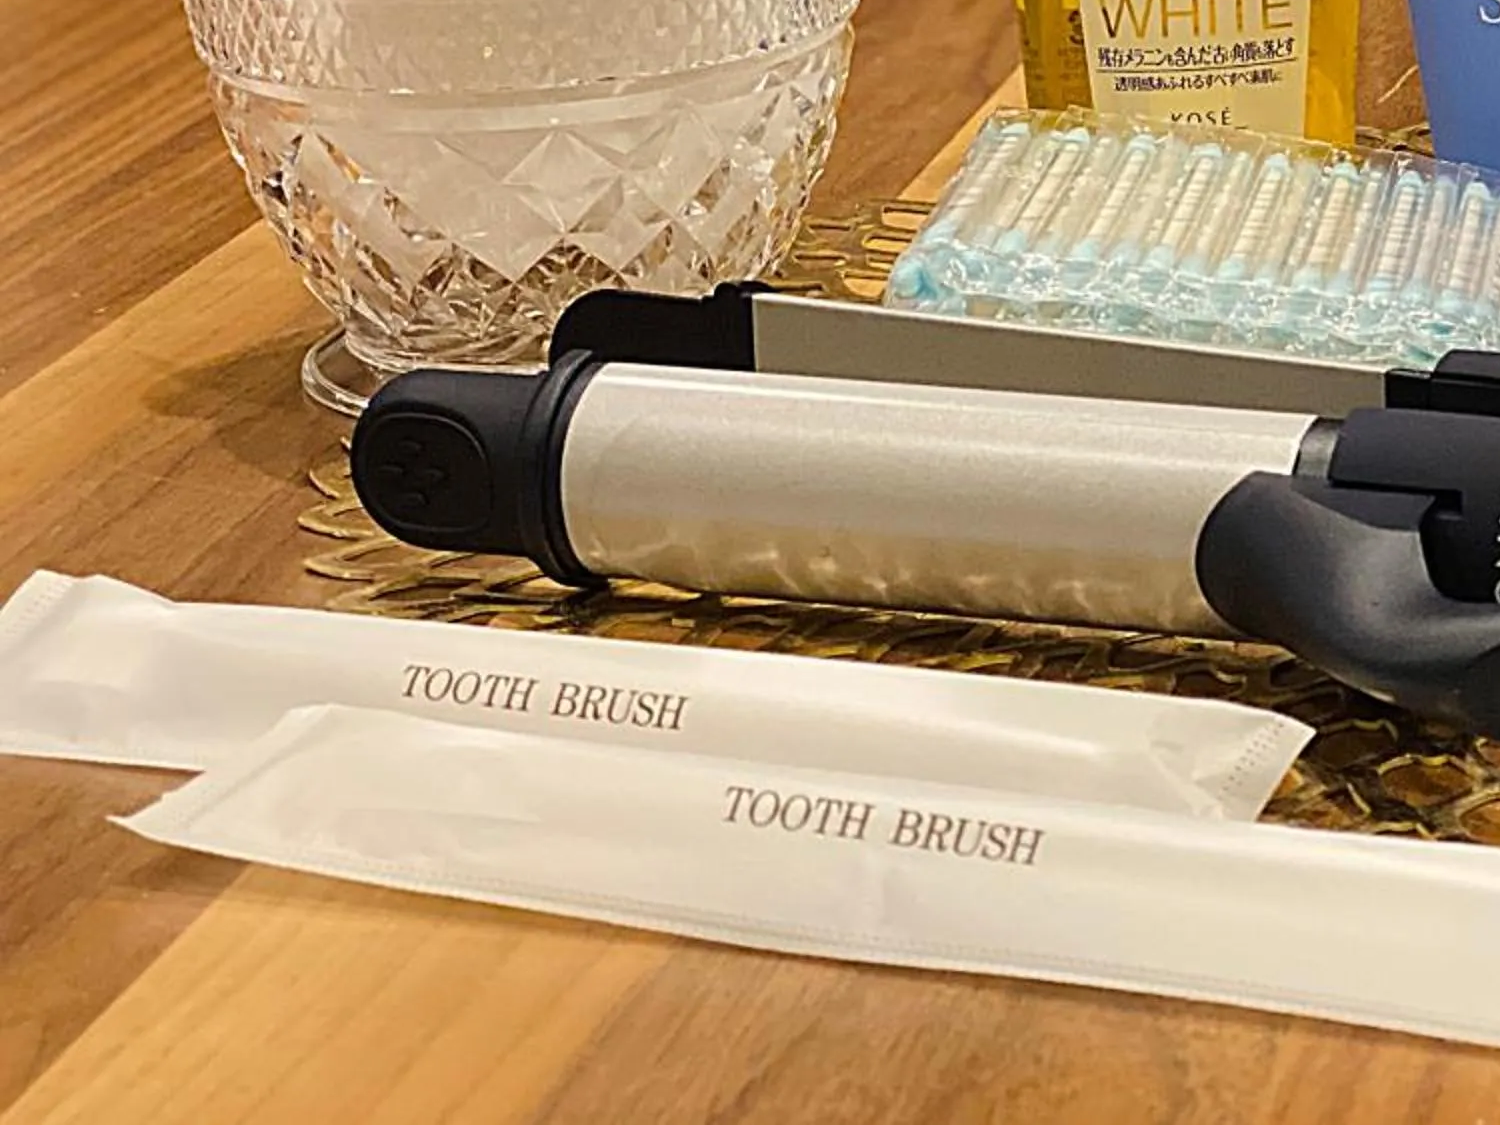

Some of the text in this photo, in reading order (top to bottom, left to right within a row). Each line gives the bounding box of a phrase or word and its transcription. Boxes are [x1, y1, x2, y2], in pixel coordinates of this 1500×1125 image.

[401, 664, 690, 731] TOOTH BRUSH
[722, 784, 1047, 867] TOOTH BRUSH
